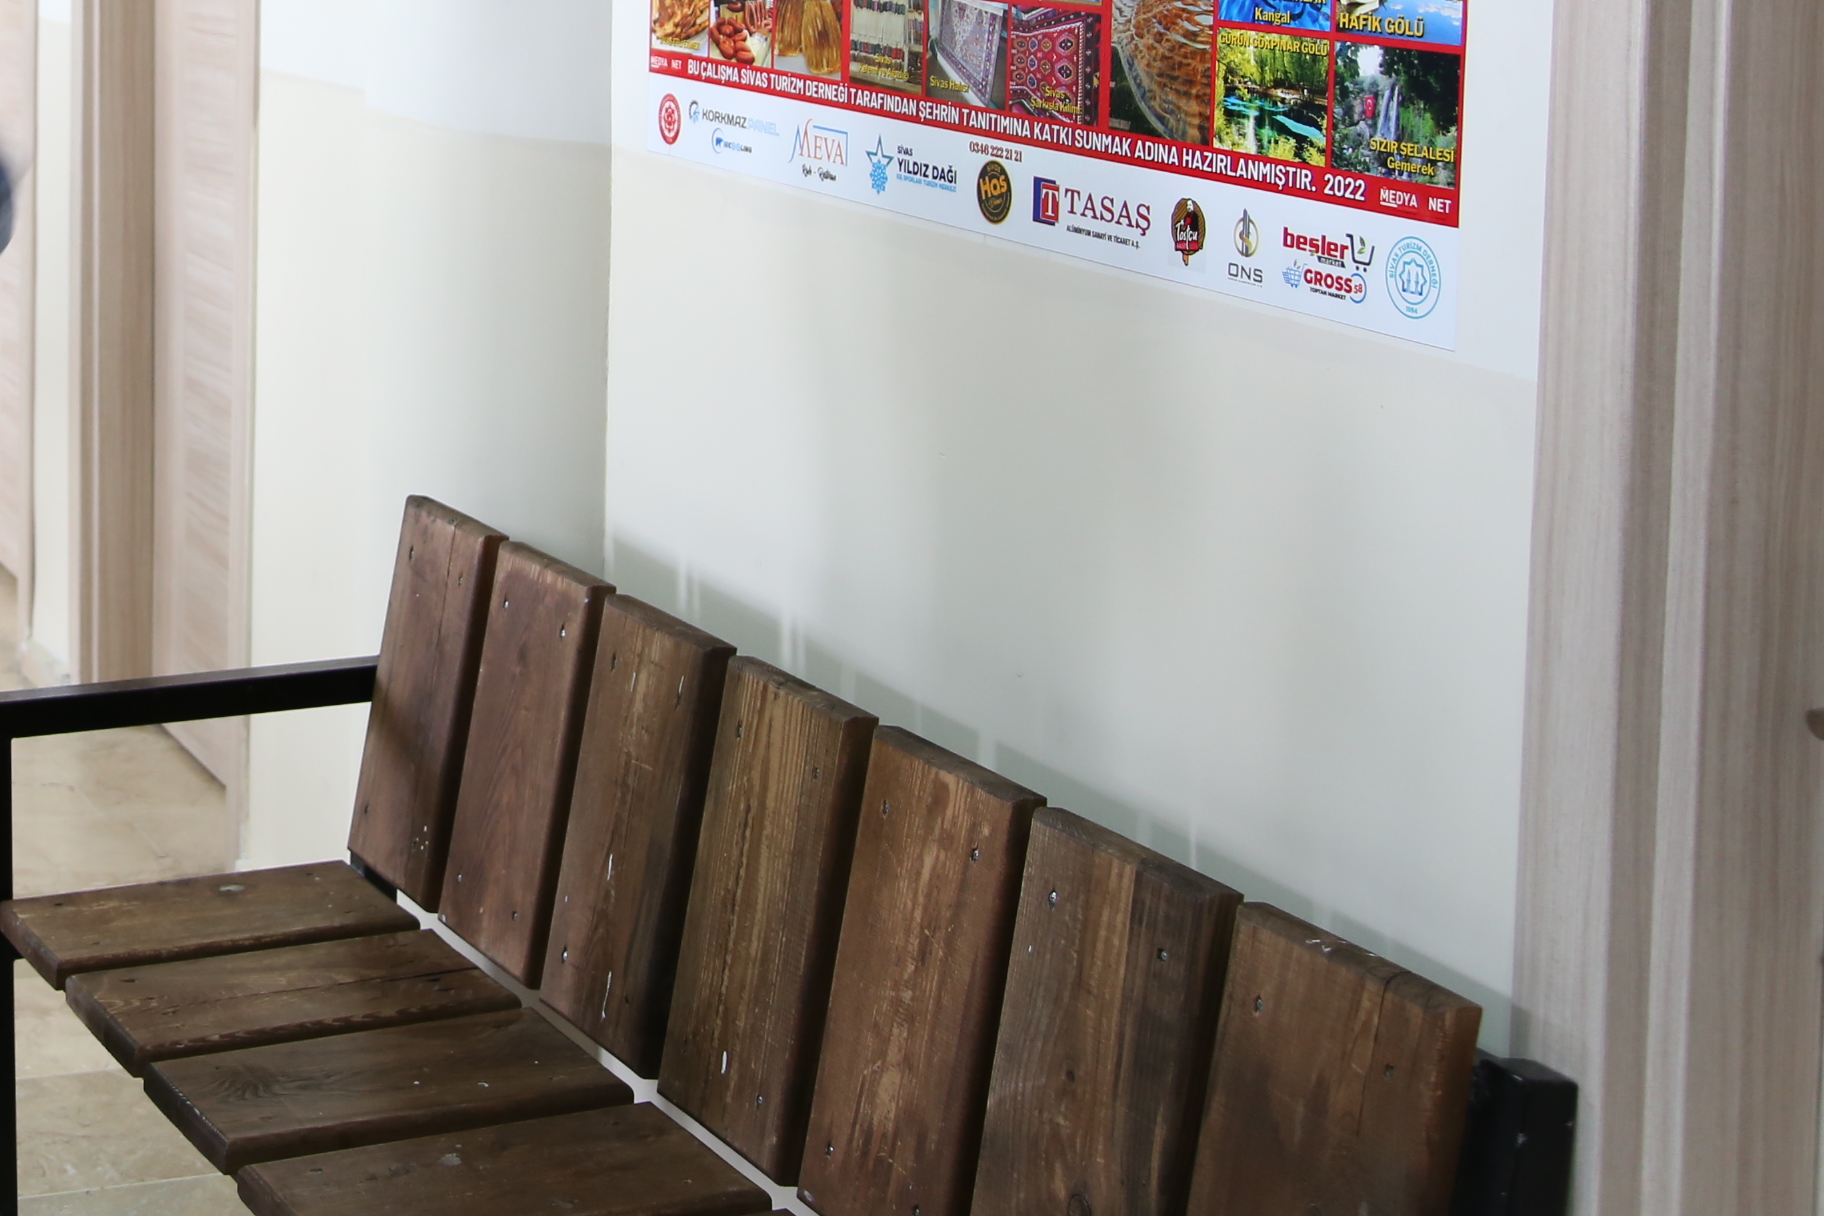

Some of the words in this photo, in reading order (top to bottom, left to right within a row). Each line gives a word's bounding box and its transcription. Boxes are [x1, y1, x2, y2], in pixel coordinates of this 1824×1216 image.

[1254, 7, 1292, 26] Kangal
[1338, 11, 1382, 33] HAFİK
[1385, 15, 1425, 37] GÖLÜ
[671, 59, 682, 70] NET
[930, 76, 949, 89] Sivas
[687, 59, 700, 75] BU
[700, 61, 740, 84] ÇALIŞMA
[740, 65, 768, 88] SİVAS
[769, 72, 804, 96] TURİZM
[805, 80, 848, 103] DERNEĞİ
[849, 90, 917, 117] TARAFINDAN
[918, 101, 959, 125] ŞEHRİN
[962, 109, 1031, 138] TANITIMINA
[1034, 122, 1072, 146] KATKI
[1075, 128, 1131, 157] SUNMAK
[1134, 139, 1178, 166] ADINA
[1182, 147, 1317, 191] HAZIRLANMIŞTIR.
[1323, 173, 1366, 201] 2022
[702, 108, 747, 129] KORKMAZ
[788, 119, 846, 166] MEVA
[897, 144, 913, 156] SİVAS
[969, 141, 989, 155] 0346
[990, 145, 1003, 159] 222
[1005, 148, 1013, 160] 21
[1014, 150, 1022, 162] 21
[1370, 137, 1398, 154] SIZIR
[1400, 142, 1455, 163] ŞELALESİ
[897, 157, 929, 178] YILDIZ
[932, 165, 957, 185] DAĞI
[1387, 156, 1435, 175] Gemerek
[1065, 188, 1151, 236] TASAŞ
[1380, 187, 1418, 208] MEDYA
[1428, 197, 1452, 214] NET
[1283, 226, 1350, 261] beşler
[1228, 262, 1263, 283] ONS
[1303, 268, 1353, 294] GROSS
[1353, 283, 1363, 294] 58
[1328, 291, 1346, 300] MARKET
